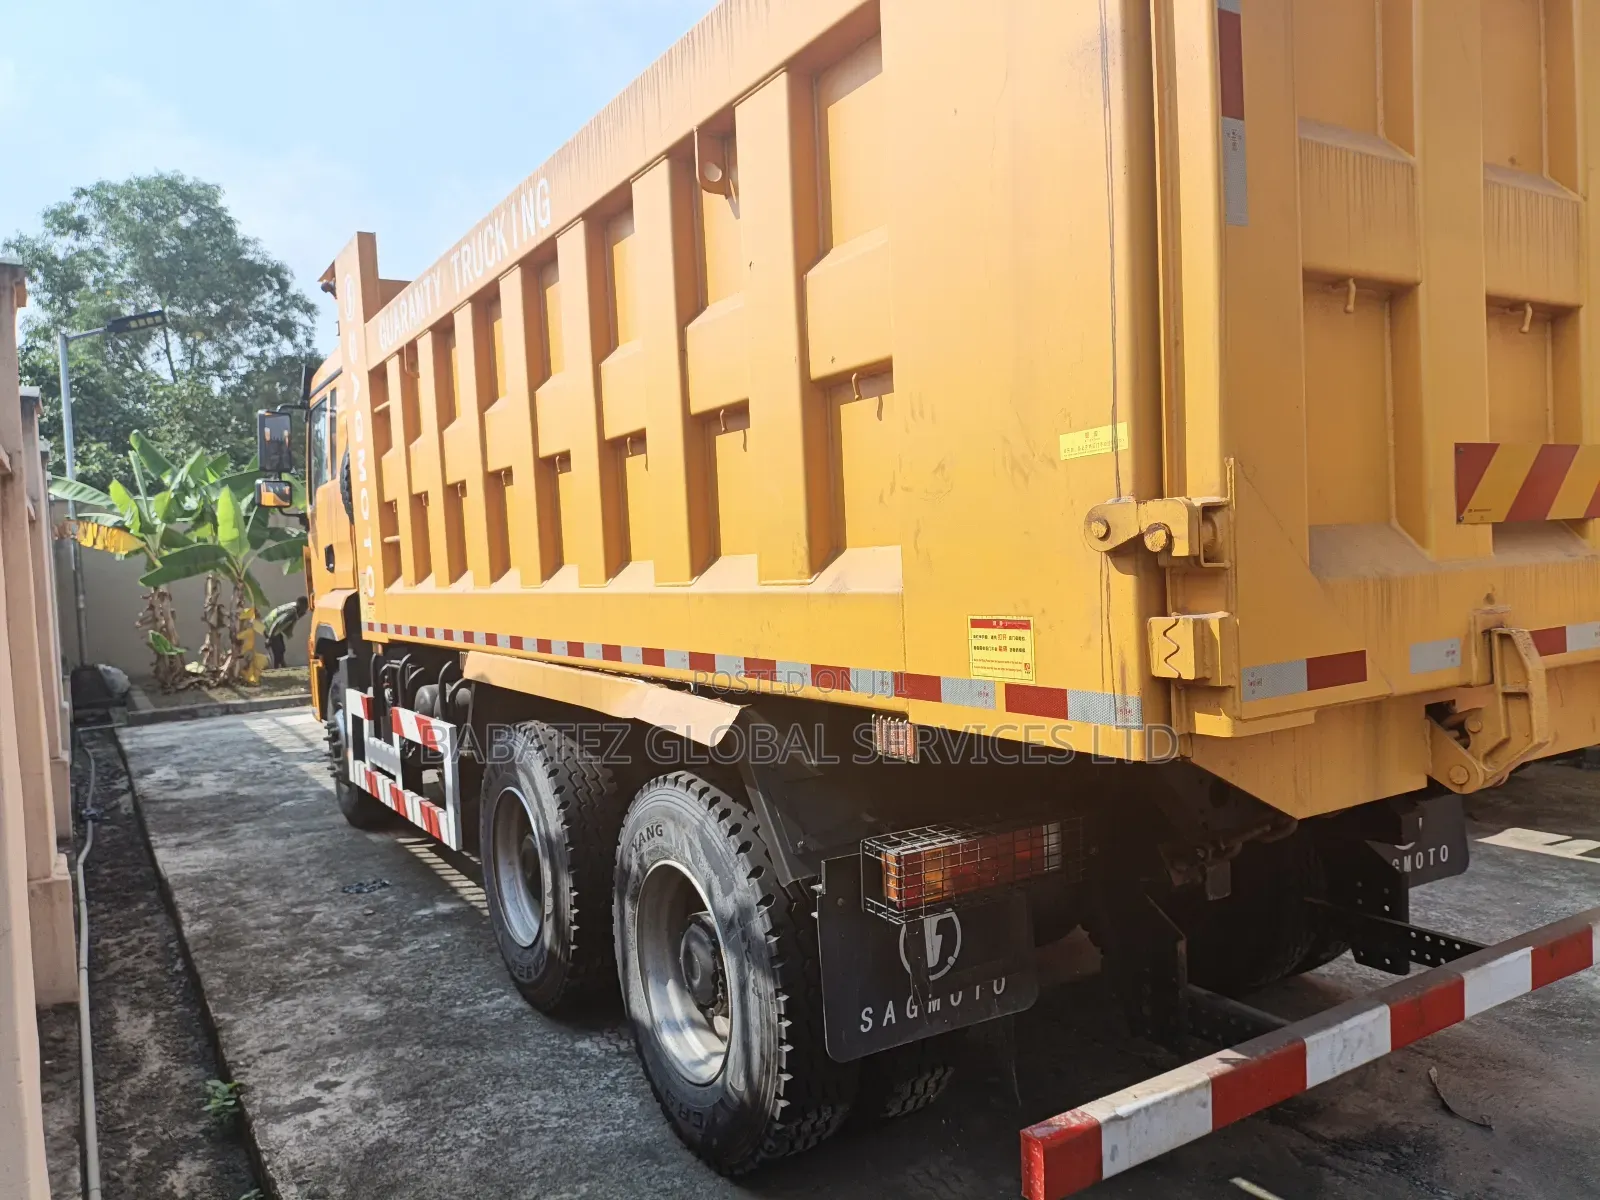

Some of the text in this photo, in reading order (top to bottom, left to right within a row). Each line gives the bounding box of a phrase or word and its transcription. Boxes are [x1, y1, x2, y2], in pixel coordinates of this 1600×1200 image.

[379, 177, 551, 351] GUARANTY TRUCKING
[348, 330, 375, 598] SAGMOTO
